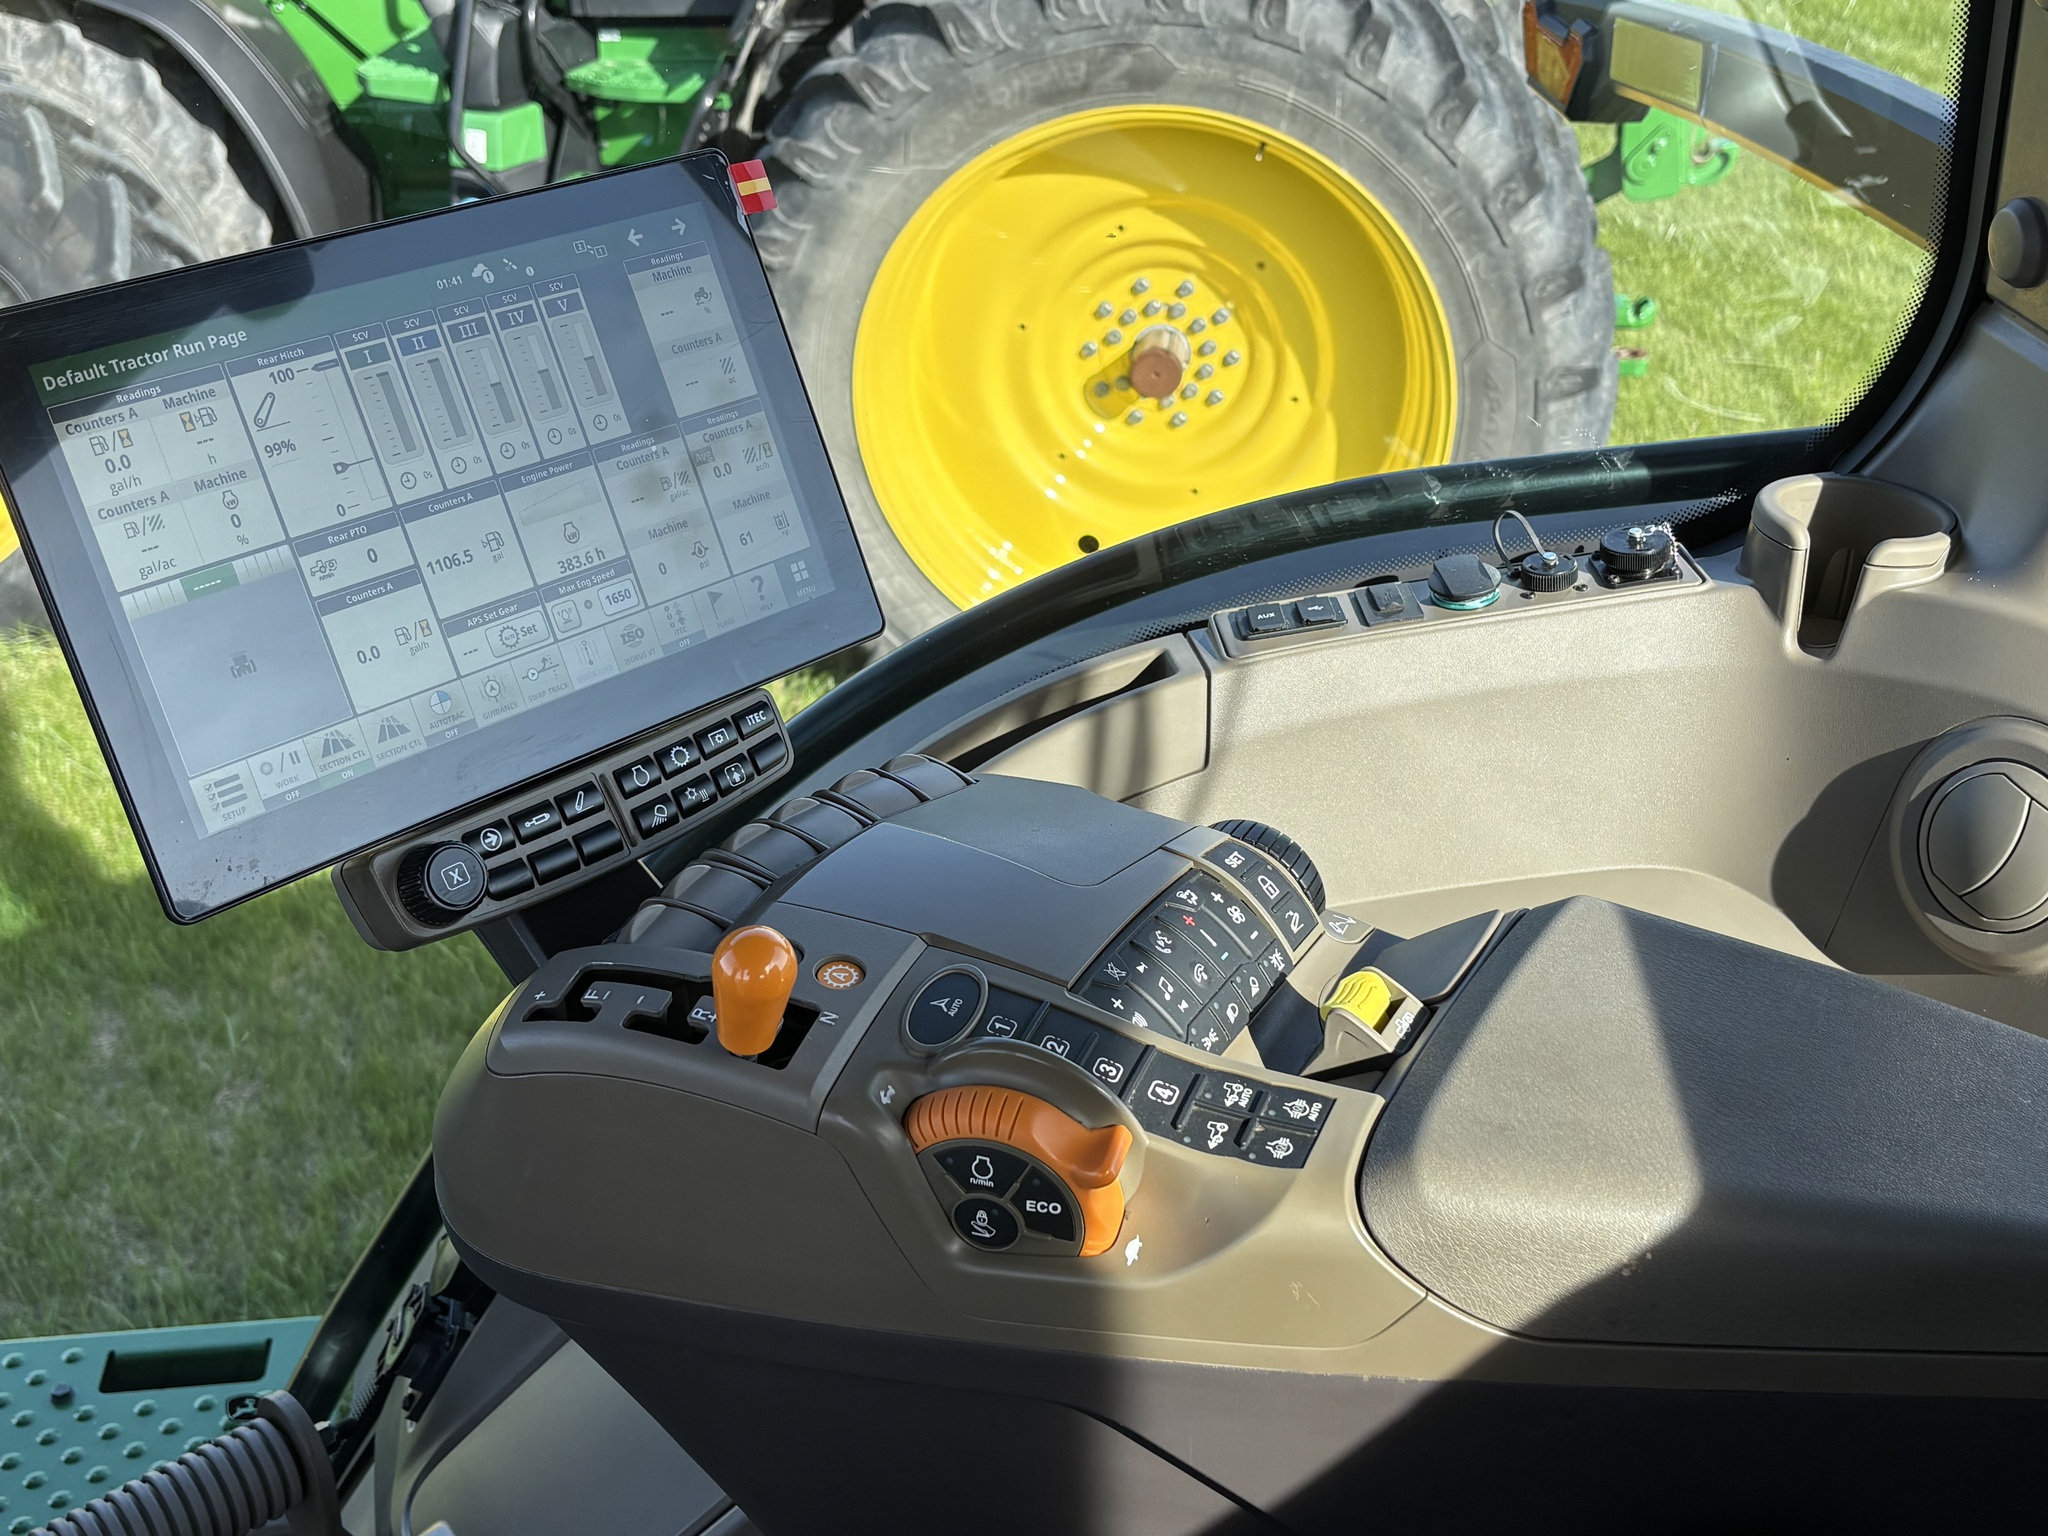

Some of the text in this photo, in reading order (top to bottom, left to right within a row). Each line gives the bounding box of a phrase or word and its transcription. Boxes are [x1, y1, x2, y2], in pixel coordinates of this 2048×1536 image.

[650, 251, 684, 266] Readings
[652, 264, 693, 282] Machine
[436, 276, 463, 290] 01:41
[549, 282, 564, 292] SCV
[502, 293, 517, 303] SCV
[556, 298, 568, 312] V
[453, 305, 470, 316] SCV
[507, 310, 525, 326] IV
[404, 318, 420, 328] SCV
[458, 322, 480, 338] III
[352, 331, 369, 342] SCV
[411, 335, 428, 350] II
[671, 332, 722, 355] Counters A
[42, 329, 248, 392] Default Tractor Run Page
[256, 348, 305, 368] Rear Hitch
[363, 350, 374, 364] I
[268, 368, 296, 386] 100
[116, 385, 162, 404] Readings
[162, 387, 216, 410] Machine
[65, 407, 139, 436] Counters A
[613, 414, 622, 422] 0s
[706, 410, 739, 425] Readings
[568, 428, 577, 436] 0s
[702, 420, 753, 444] Counters A
[264, 439, 296, 458] 99%
[521, 441, 530, 450] 0s
[620, 436, 655, 452] Readings
[104, 454, 132, 474] 0.0
[208, 454, 216, 466] h
[473, 456, 483, 464] 0s
[616, 446, 670, 471] Counters A
[694, 451, 713, 463] Avg
[520, 461, 574, 485] Engine Power
[713, 462, 732, 478] 0.0
[756, 461, 770, 472] ac/h
[193, 468, 248, 492] Machine
[424, 470, 433, 480] 0s
[109, 476, 142, 496] gal/h
[428, 492, 474, 513] Counters A
[669, 489, 690, 503] gal/ac
[732, 490, 771, 511] Machine
[97, 490, 170, 520] Counters A
[336, 504, 346, 517] 0
[230, 514, 242, 528] 0
[327, 525, 368, 545] Rear PTO
[647, 519, 688, 540] Machine
[236, 534, 250, 546] %
[739, 531, 754, 546] 61
[367, 548, 378, 564] 0
[426, 548, 474, 576] 1106.5
[492, 552, 504, 564] gal
[558, 547, 606, 575] 383.6 h
[138, 557, 177, 580] gal/ac
[658, 562, 668, 576] 0
[699, 559, 710, 570] psi
[558, 568, 616, 596] Max Eng Speed
[346, 582, 394, 604] Counters A
[605, 588, 632, 606] 1650
[796, 584, 816, 598] MENU
[467, 604, 518, 628] APS Set Gear
[1257, 612, 1275, 620] AUX
[520, 623, 538, 637] Set
[620, 627, 645, 646] ISO
[409, 641, 430, 656] gal/h
[678, 638, 691, 648] OFF
[356, 645, 382, 664] 0.0
[624, 651, 647, 666] ISOBUS
[528, 682, 570, 703] SWAP TRACK
[482, 700, 519, 720] GUIDANCE
[429, 710, 466, 730] AUTOTRAC
[445, 728, 459, 739] OFF
[376, 739, 422, 762] SECTION CTL
[318, 750, 366, 773] SECTION CTL
[275, 774, 300, 790] WORK
[341, 768, 354, 780] ON
[285, 790, 300, 802] OFF
[222, 806, 247, 822] SETUP
[1225, 851, 1246, 868] SET
[584, 988, 600, 1000] F
[692, 1007, 710, 1021] R
[948, 998, 964, 1017] AUTO
[819, 1011, 840, 1026] N
[994, 1022, 1011, 1031] 1
[1046, 1041, 1064, 1054] 2
[1099, 1063, 1117, 1076] 3
[1154, 1086, 1174, 1100] 4
[1238, 1088, 1253, 1108] AUTO
[1308, 1102, 1323, 1122] AUTO
[969, 1176, 994, 1188] n/min
[1026, 1200, 1062, 1216] ECO
